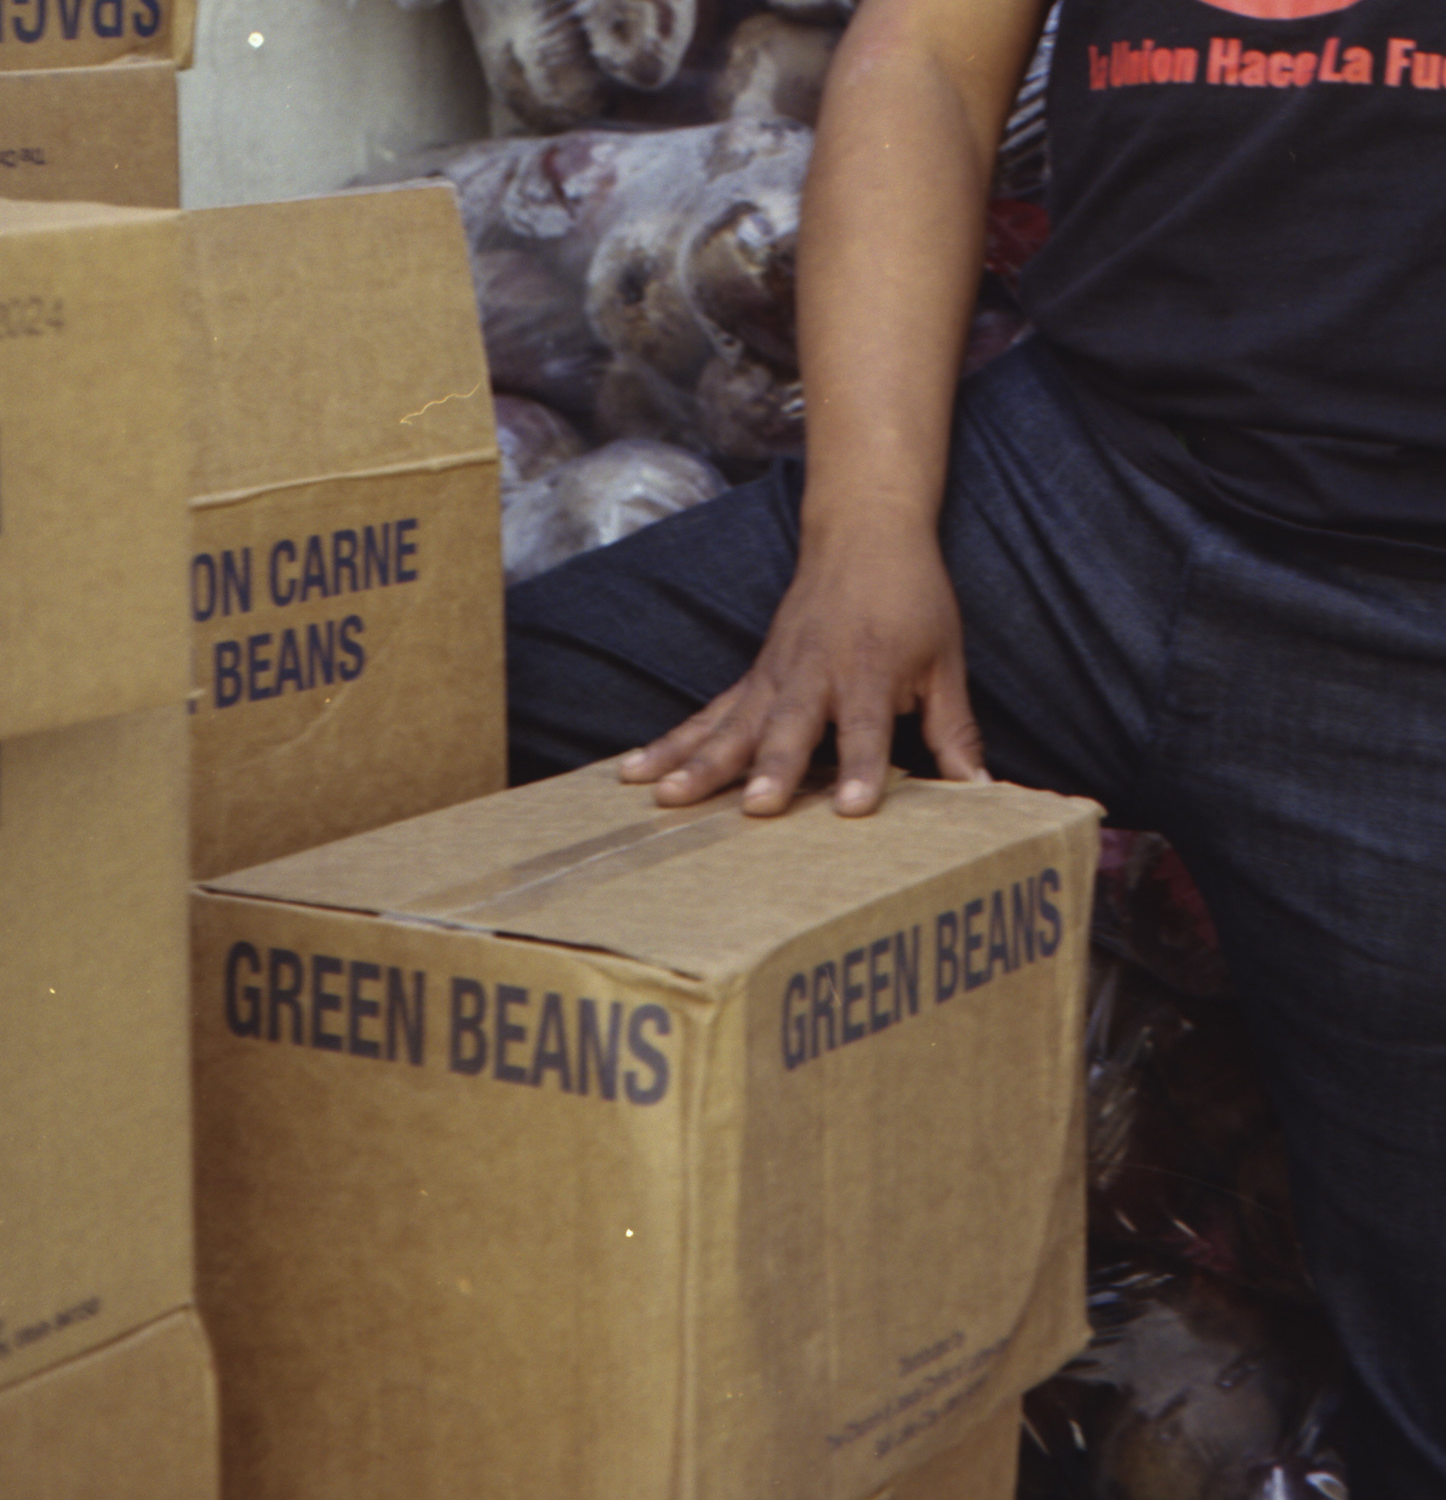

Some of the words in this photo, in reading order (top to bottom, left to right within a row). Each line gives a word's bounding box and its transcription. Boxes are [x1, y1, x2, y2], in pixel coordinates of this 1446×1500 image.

[1206, 36, 1318, 88] Hace
[1319, 37, 1373, 84] La
[269, 518, 418, 608] CARNE
[213, 614, 365, 710] BEANS
[782, 924, 921, 1072] GREEN
[934, 866, 1063, 1003] BEANS
[224, 940, 426, 1068] GREEN
[449, 978, 670, 1106] BEANS
